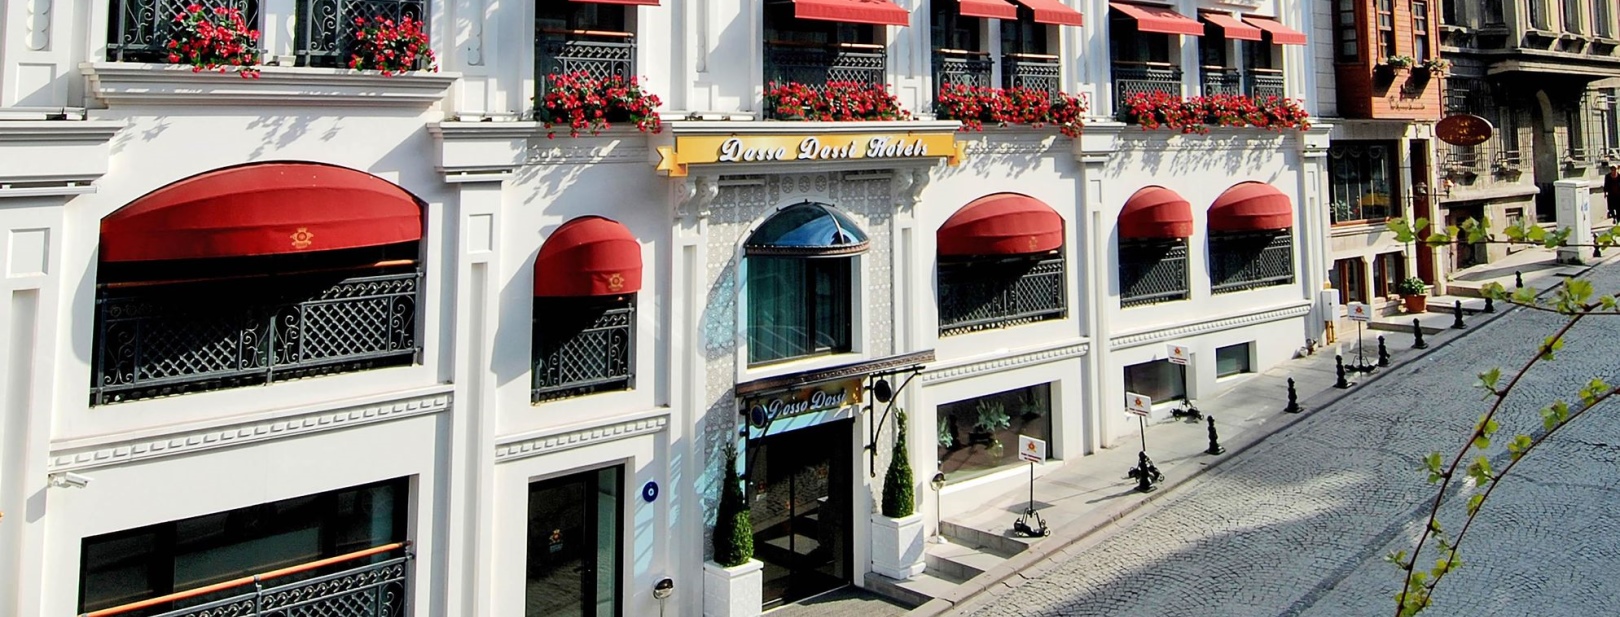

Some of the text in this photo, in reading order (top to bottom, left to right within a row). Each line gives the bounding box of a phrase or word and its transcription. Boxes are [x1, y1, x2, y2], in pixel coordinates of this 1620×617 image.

[719, 135, 928, 163] Dosso Dossi Hotels
[810, 390, 847, 410] Dossi
